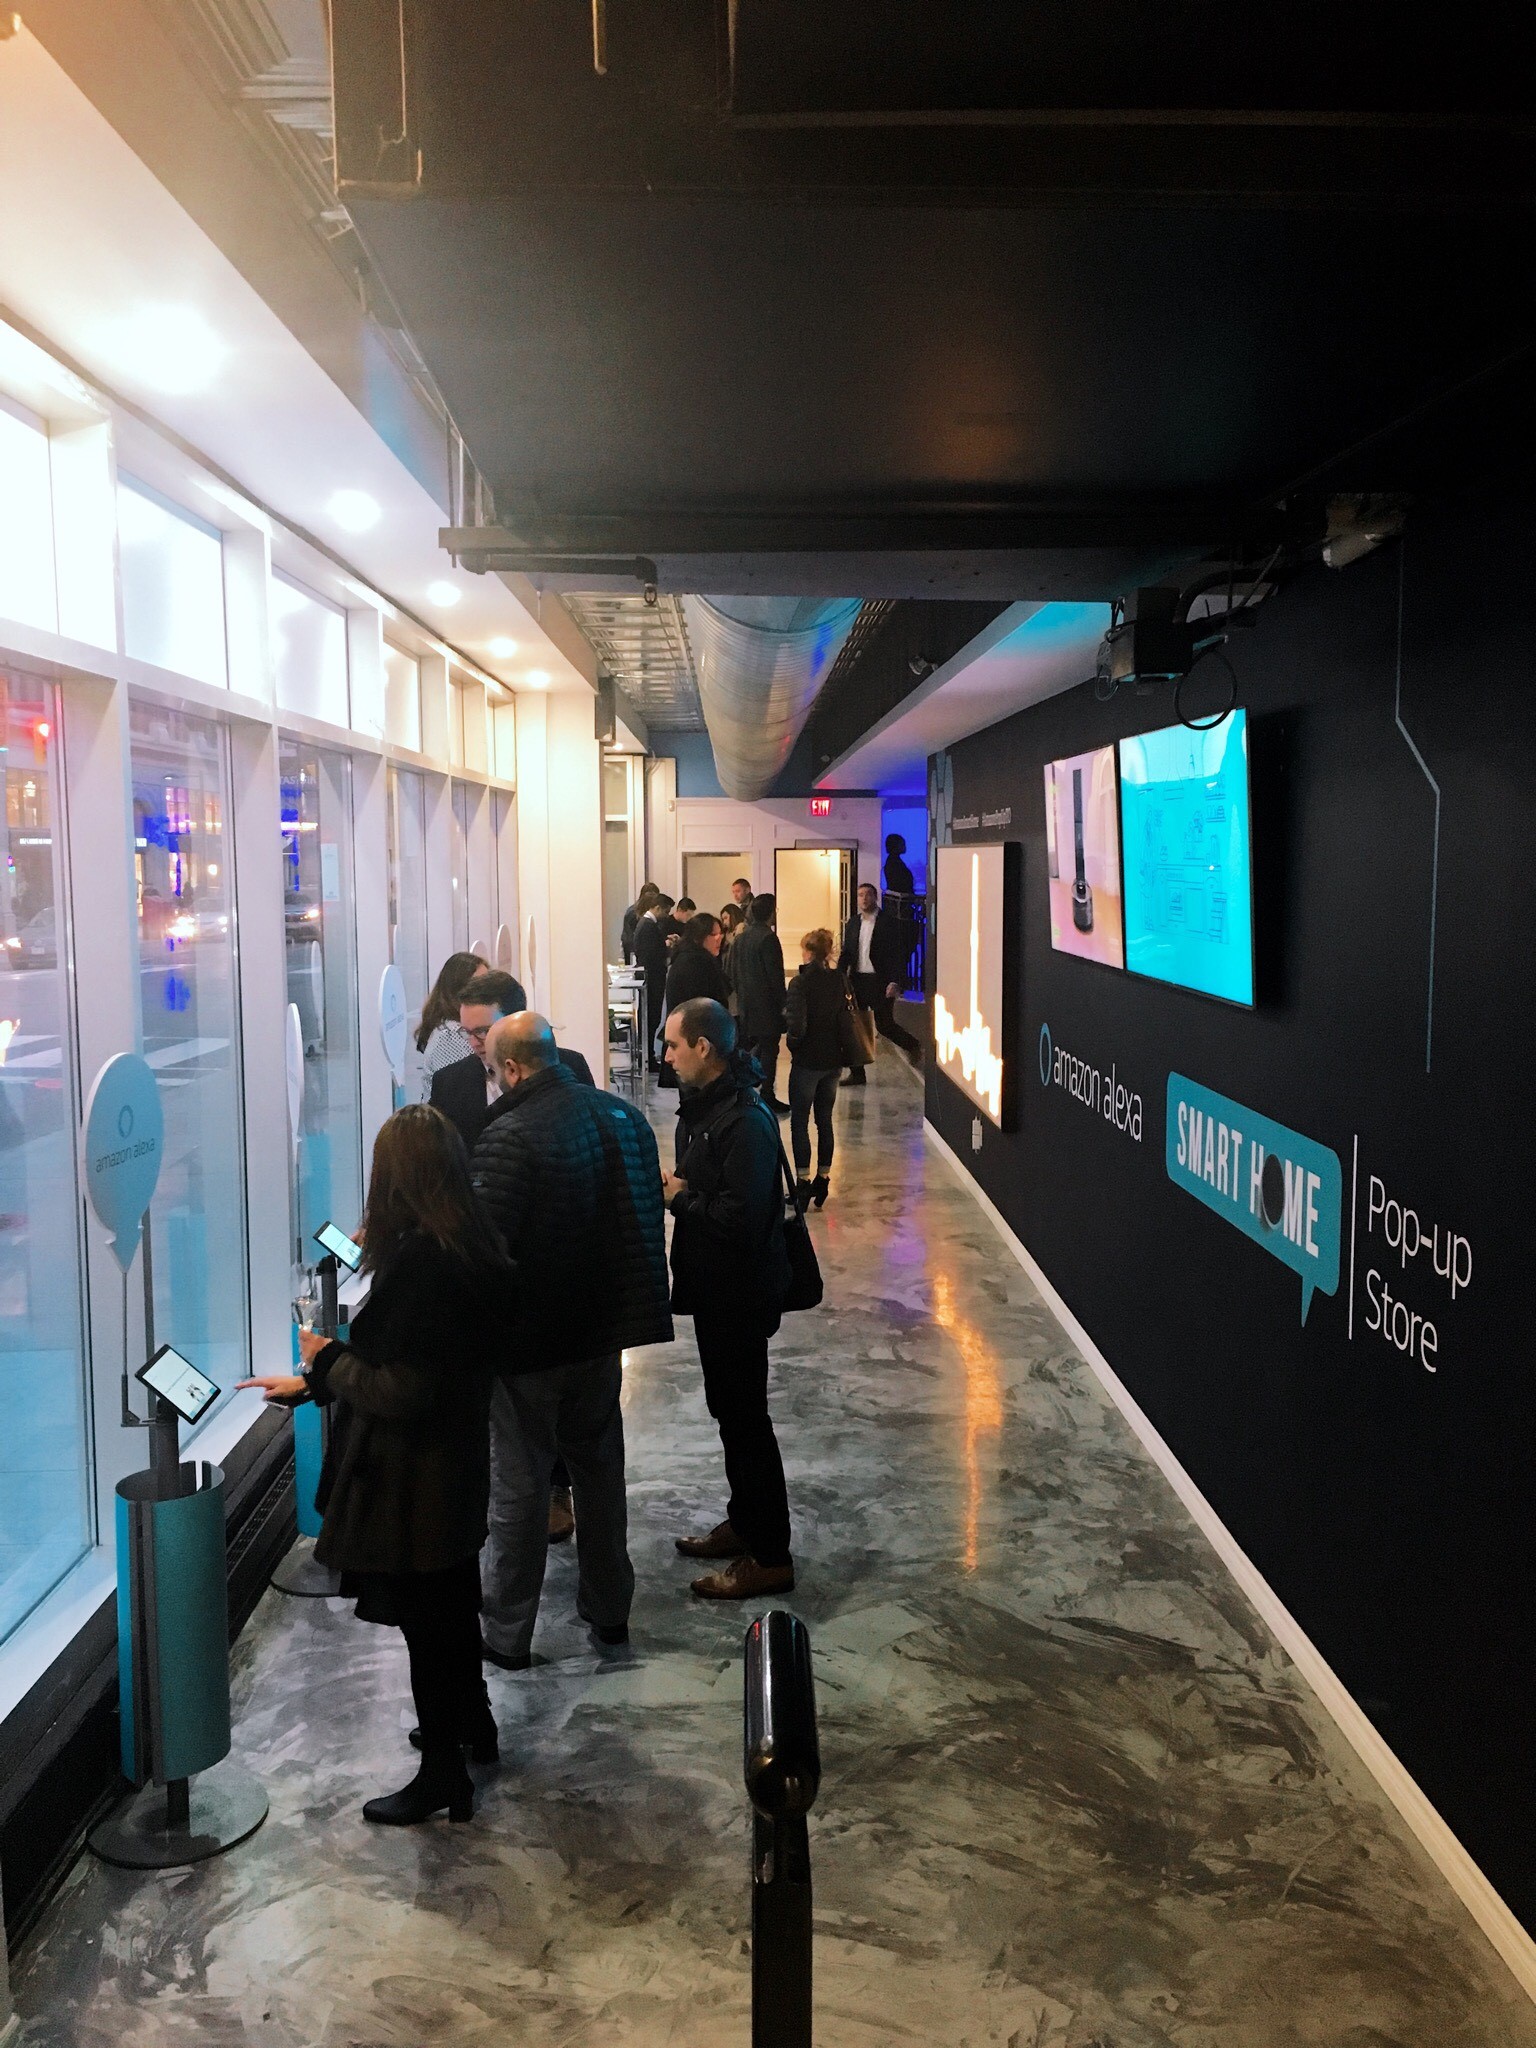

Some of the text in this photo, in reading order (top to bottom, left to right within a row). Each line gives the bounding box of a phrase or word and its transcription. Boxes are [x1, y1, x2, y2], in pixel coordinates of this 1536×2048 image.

[811, 800, 830, 815] EXIT
[1053, 1045, 1143, 1142] amazon alexa
[95, 1137, 155, 1173] amazon alexa
[1176, 1100, 1321, 1259] SMART HOME
[1368, 1174, 1472, 1300] Pop-up
[1364, 1268, 1438, 1373] Store
